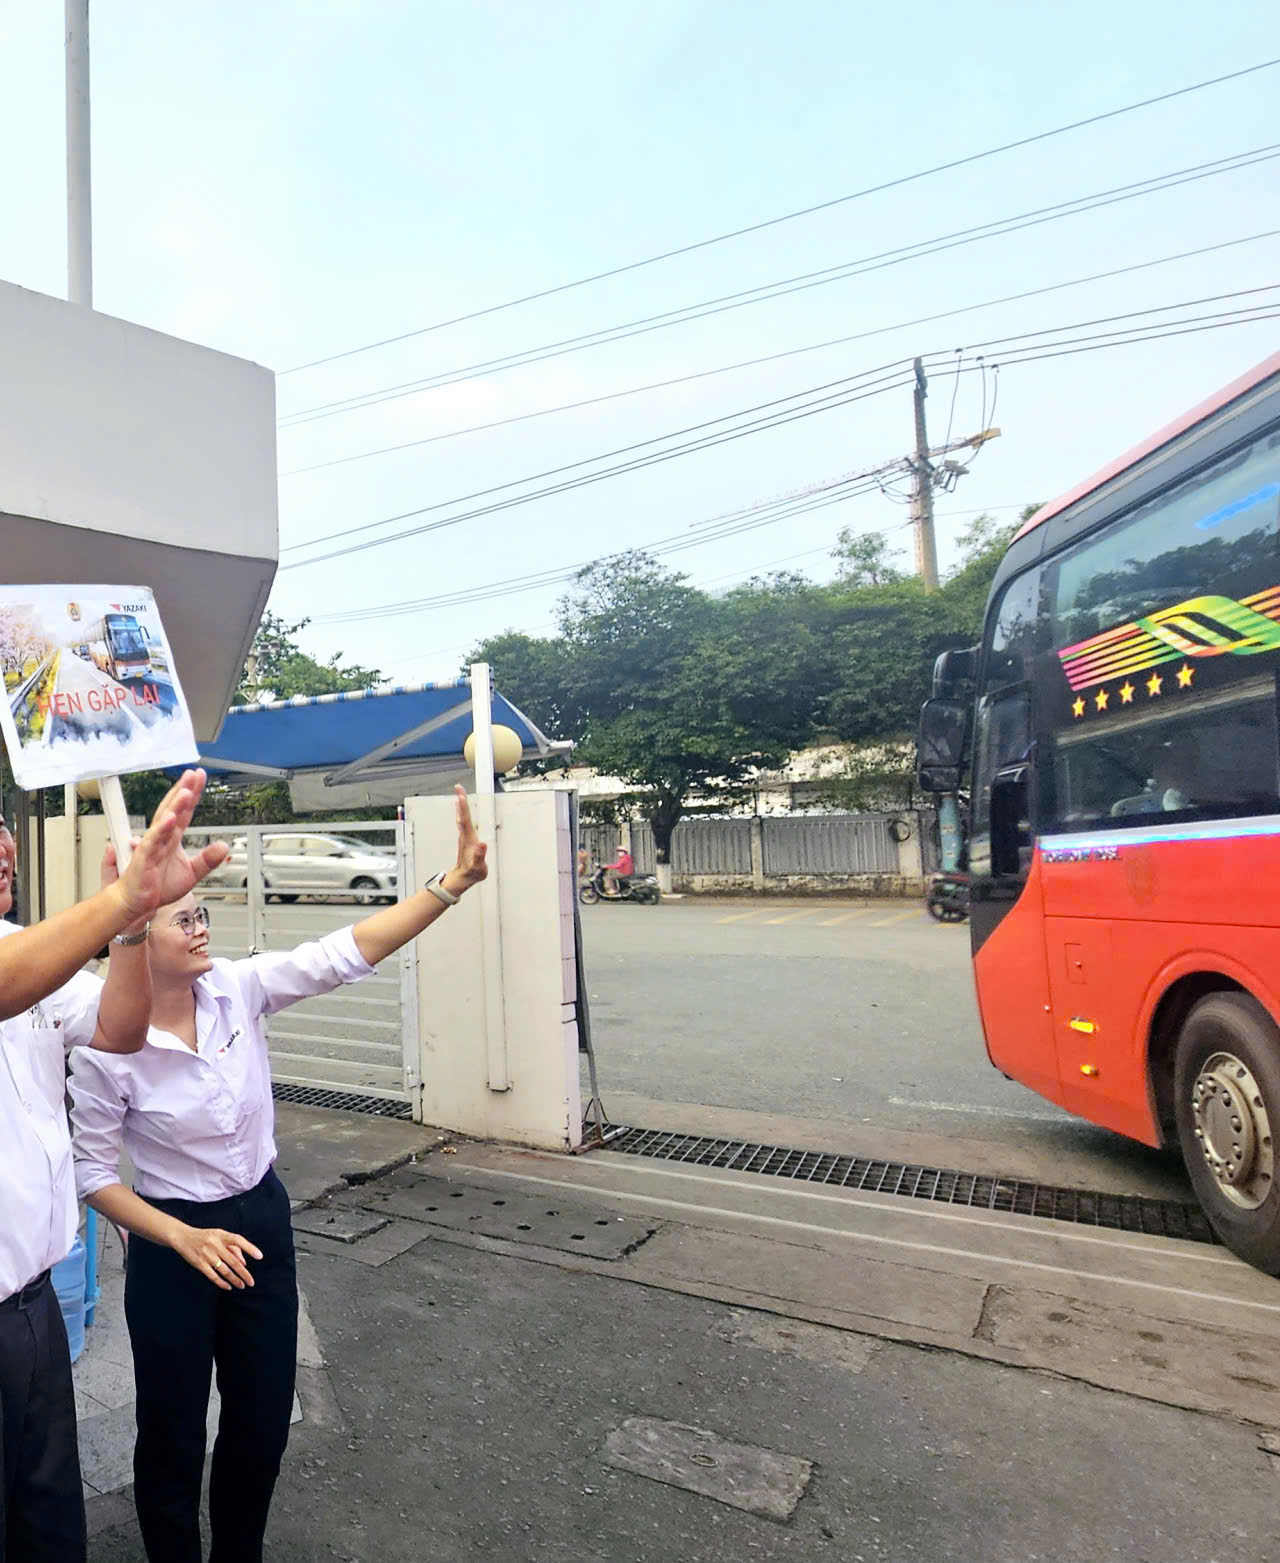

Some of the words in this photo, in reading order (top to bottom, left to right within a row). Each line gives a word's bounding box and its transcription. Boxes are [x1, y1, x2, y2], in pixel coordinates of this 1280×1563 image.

[122, 604, 147, 613] YAZAKI
[87, 683, 127, 715] GẶP
[130, 683, 160, 710] LẠI
